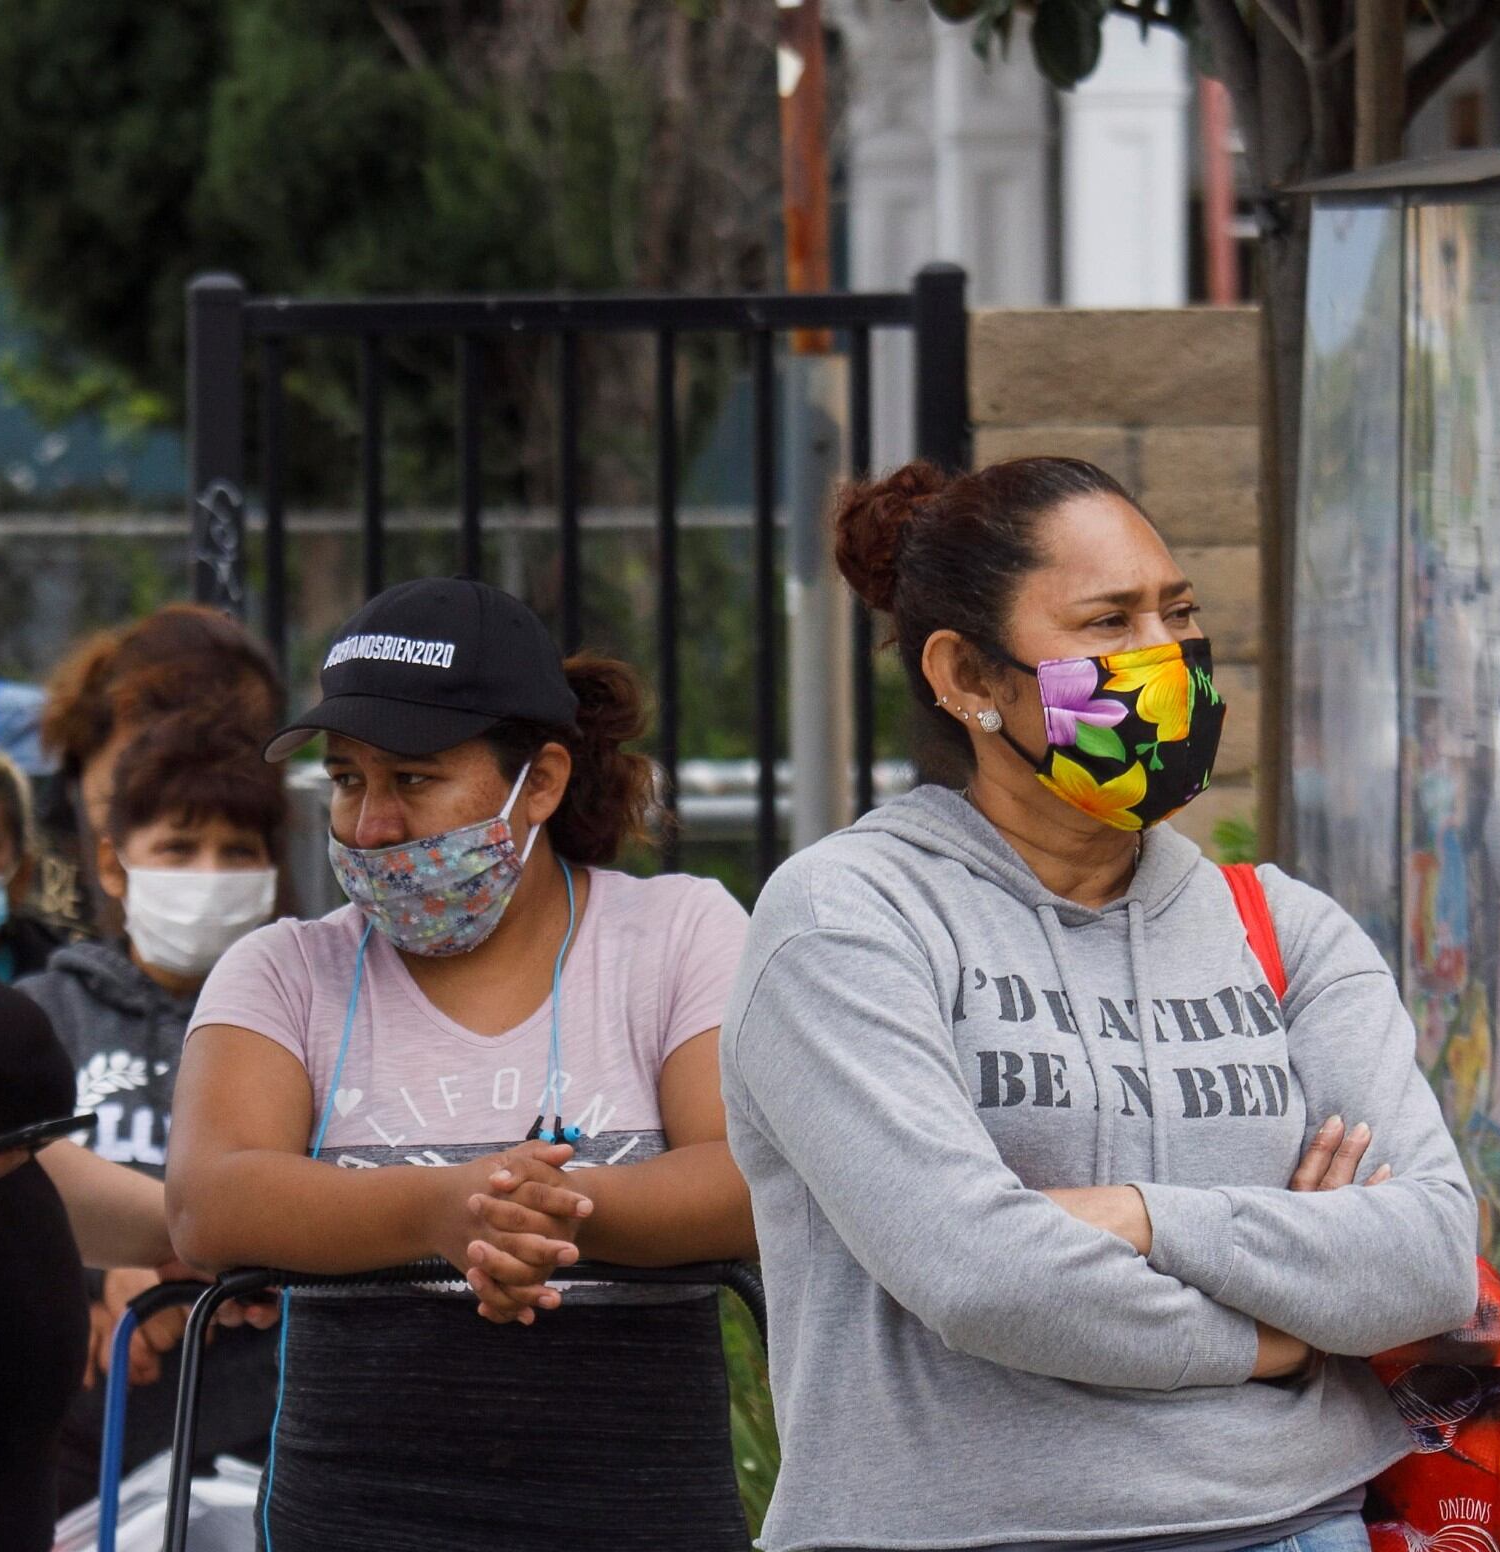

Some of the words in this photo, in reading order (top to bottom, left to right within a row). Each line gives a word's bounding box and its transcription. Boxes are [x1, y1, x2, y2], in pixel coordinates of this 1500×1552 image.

[976, 1050, 1071, 1109] BE
[1173, 1063, 1291, 1119] BED
[1438, 1497, 1493, 1525] ONIONS
